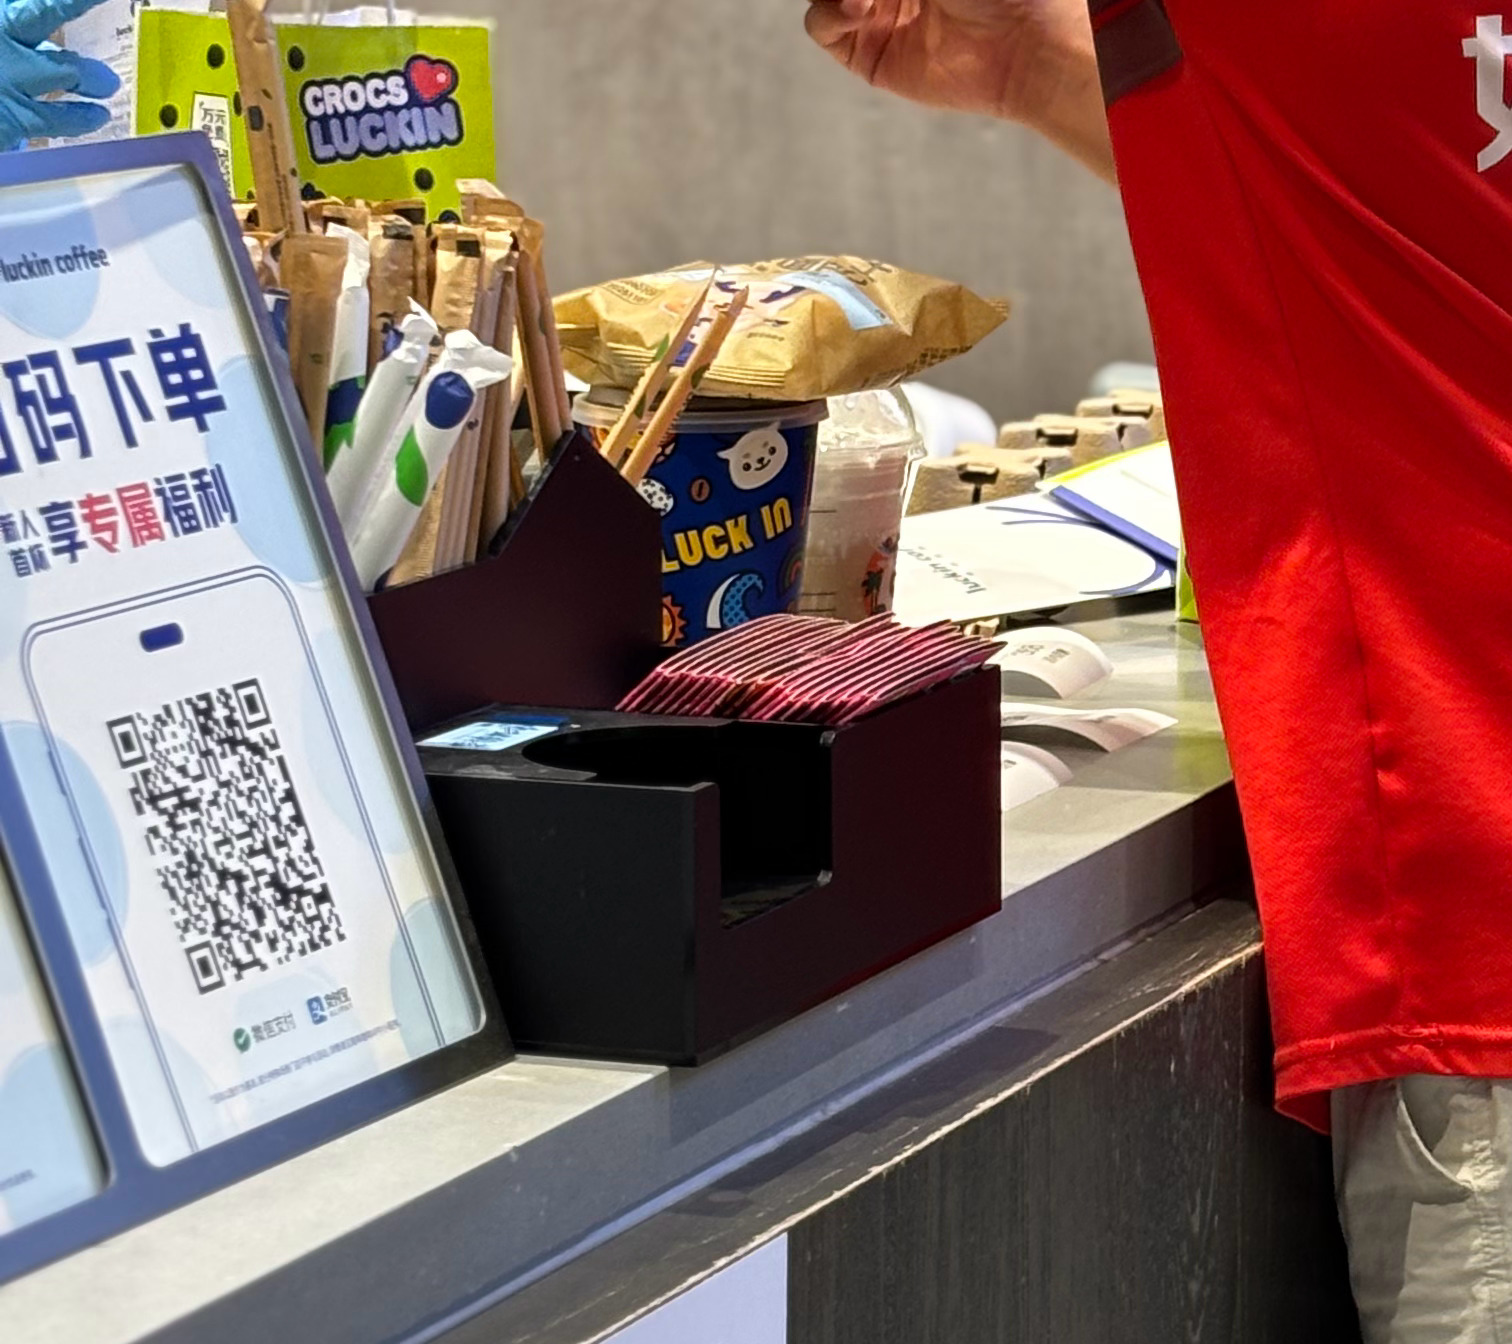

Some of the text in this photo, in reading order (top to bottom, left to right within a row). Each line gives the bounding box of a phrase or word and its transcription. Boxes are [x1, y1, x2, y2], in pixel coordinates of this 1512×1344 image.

[304, 75, 409, 118] CROCS
[309, 102, 459, 161] LUCKIN
[0, 243, 111, 282] luckin coffee
[0, 322, 227, 478] 码下单
